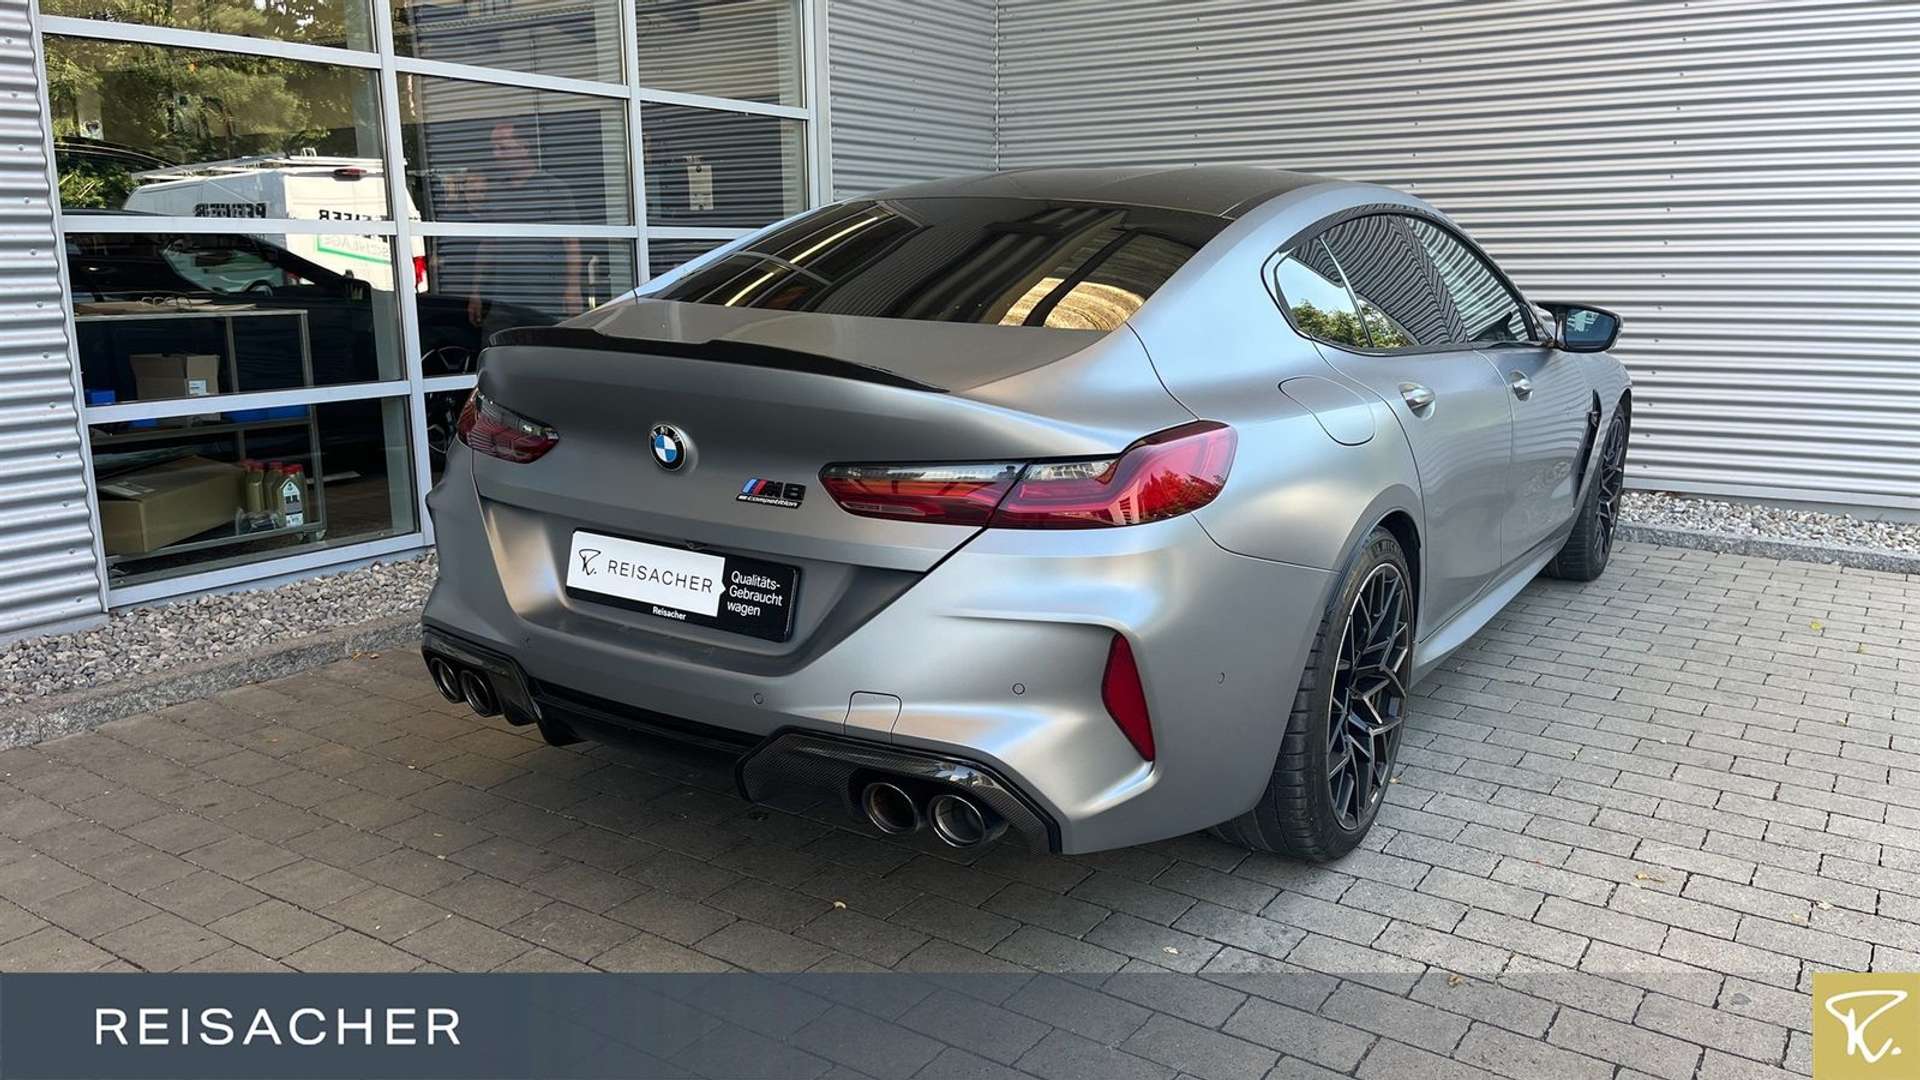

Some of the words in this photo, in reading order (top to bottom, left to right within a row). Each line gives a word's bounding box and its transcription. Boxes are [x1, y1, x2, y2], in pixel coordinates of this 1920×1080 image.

[607, 559, 713, 593] REISACHER
[731, 570, 781, 590] Qualitäts-
[729, 585, 783, 607] Gebraucht
[652, 606, 687, 621] Reisacher
[727, 601, 761, 617] wagen
